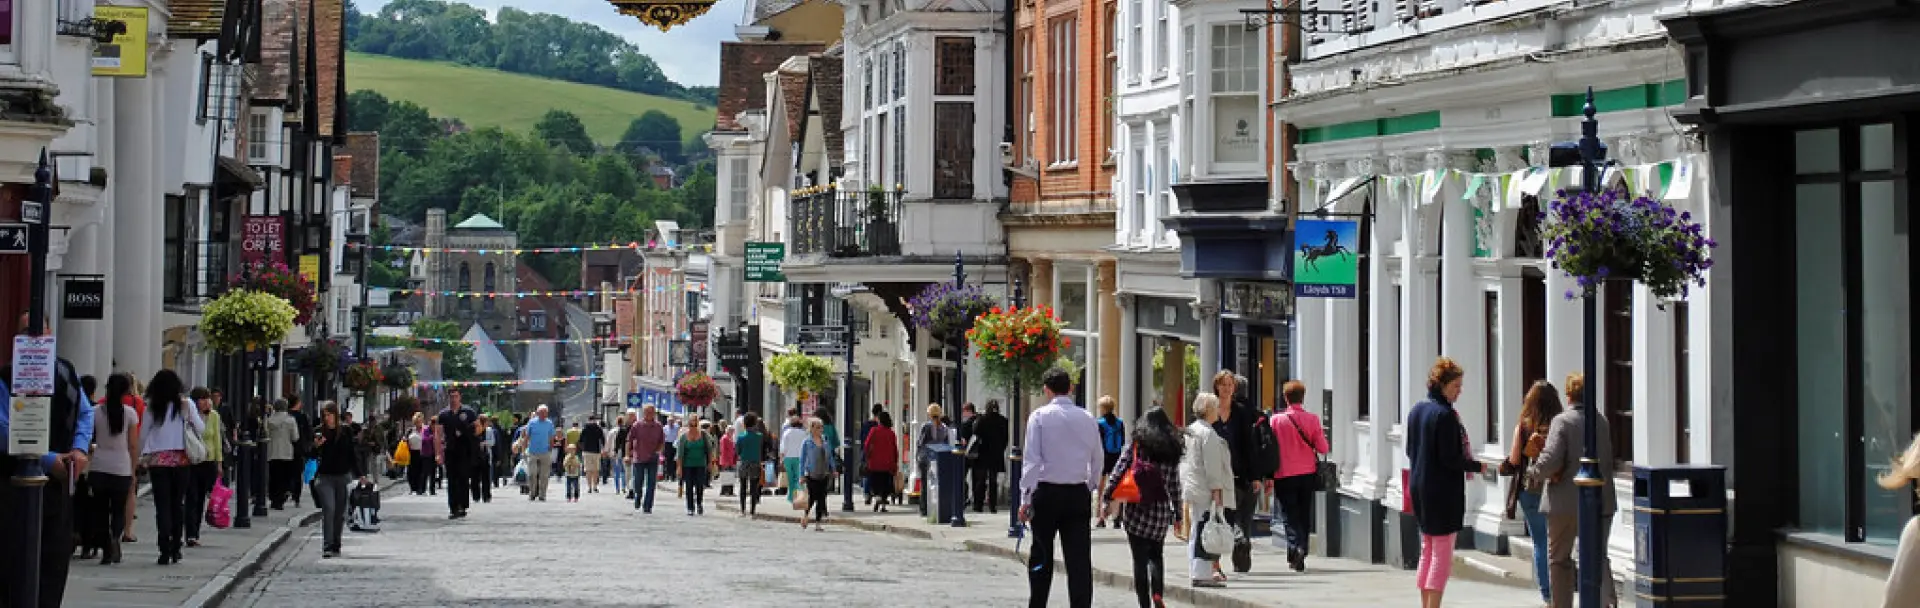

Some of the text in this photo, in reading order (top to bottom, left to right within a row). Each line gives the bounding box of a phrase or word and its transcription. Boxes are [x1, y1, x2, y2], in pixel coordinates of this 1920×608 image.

[244, 223, 281, 234] TO LET
[1303, 284, 1347, 295] Lloyds TSB
[67, 293, 101, 303] BOSS
